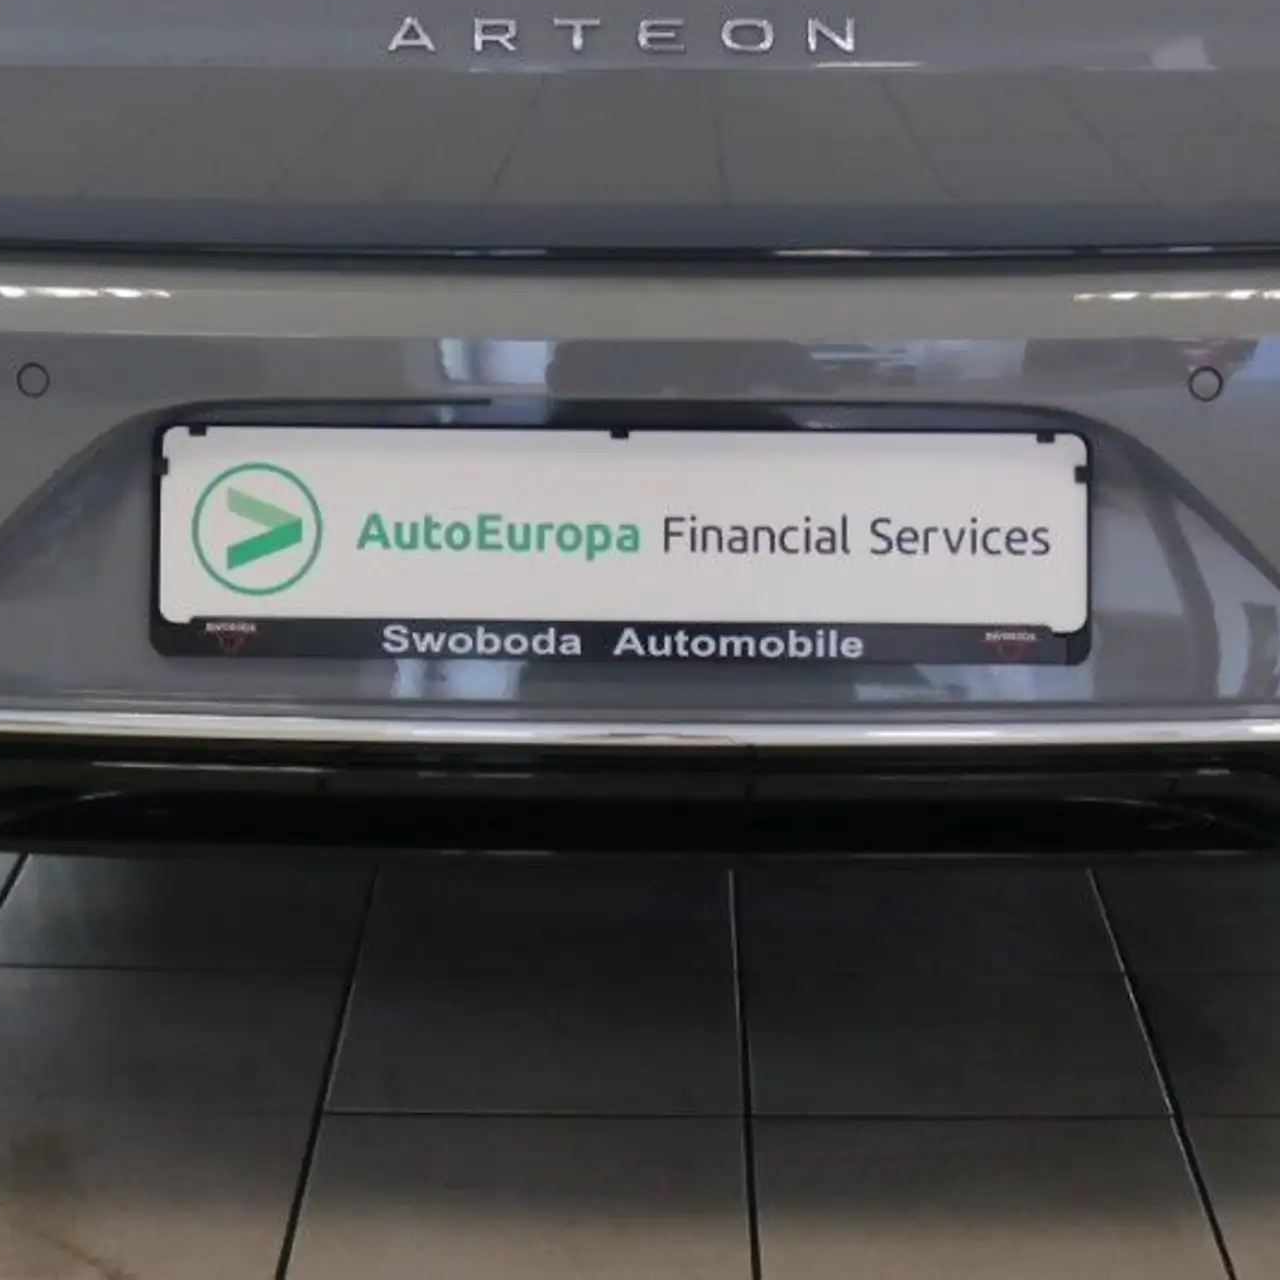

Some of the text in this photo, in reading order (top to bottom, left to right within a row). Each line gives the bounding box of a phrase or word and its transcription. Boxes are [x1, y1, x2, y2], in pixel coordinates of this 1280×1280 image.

[387, 16, 859, 54] ARTEON
[357, 513, 1051, 561] AutoEuropa Financial Services
[382, 624, 865, 659] Swoboda Automobile
